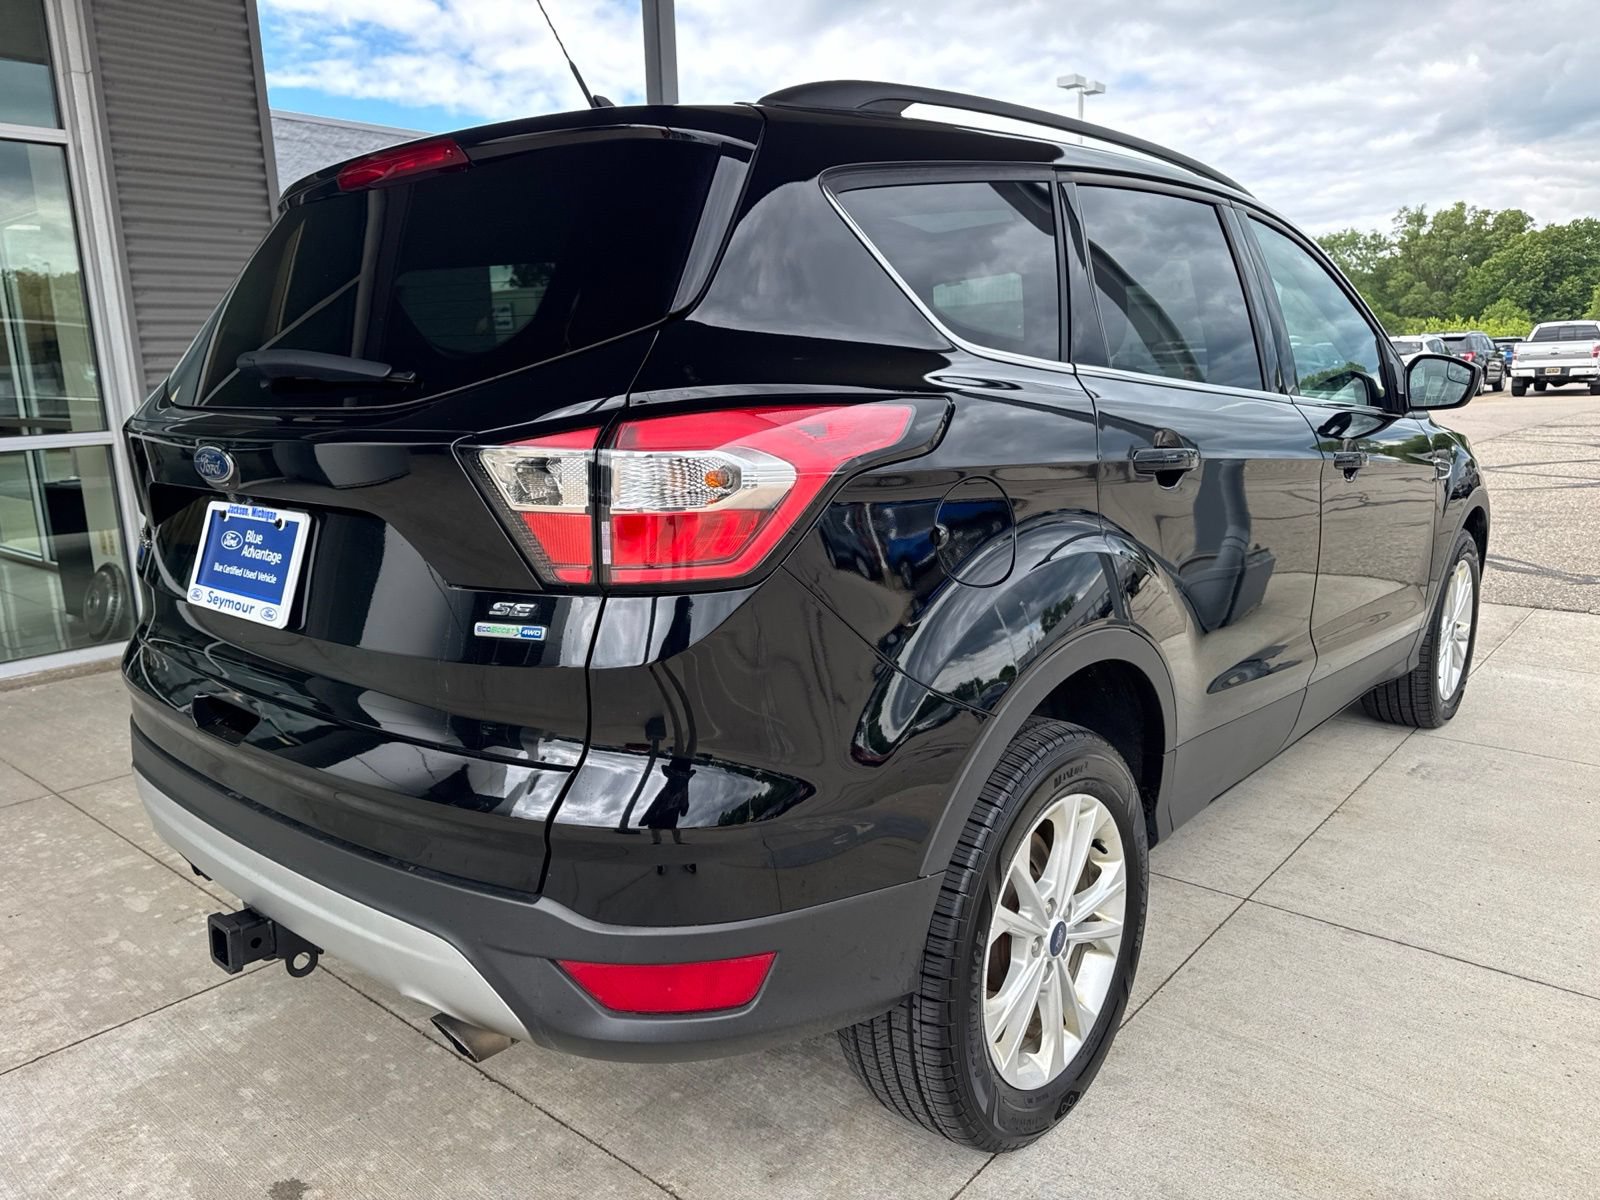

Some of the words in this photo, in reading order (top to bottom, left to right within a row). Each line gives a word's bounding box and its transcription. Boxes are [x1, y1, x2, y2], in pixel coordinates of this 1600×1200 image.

[200, 453, 222, 475] Ford
[252, 507, 277, 521] Michigan
[246, 530, 263, 544] Blue
[241, 545, 282, 565] Advantage
[207, 590, 255, 614] Seymour
[489, 602, 536, 616] SE
